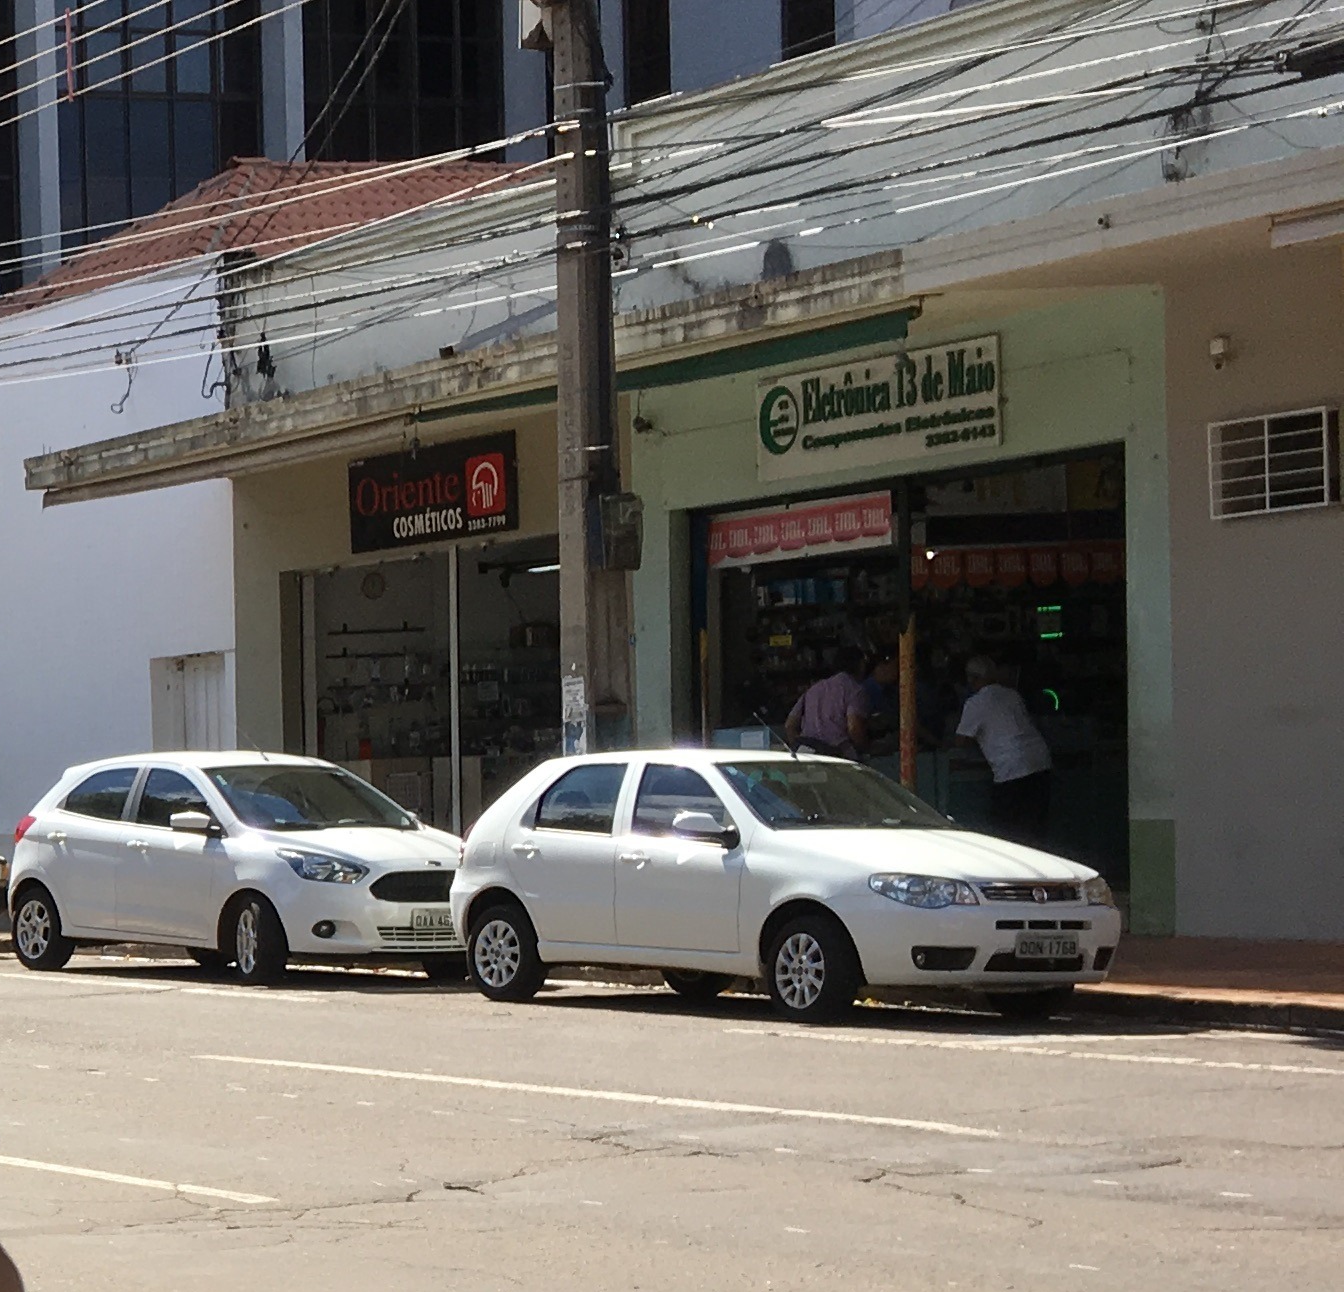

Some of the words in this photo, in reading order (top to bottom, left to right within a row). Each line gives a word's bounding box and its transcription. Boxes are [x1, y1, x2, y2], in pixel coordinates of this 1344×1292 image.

[801, 368, 892, 426] Eletrônica
[896, 354, 917, 408] 13
[921, 356, 944, 404] de
[947, 347, 996, 399] Maio
[356, 471, 462, 517] Oriente
[393, 507, 463, 539] COSMÉTICOS
